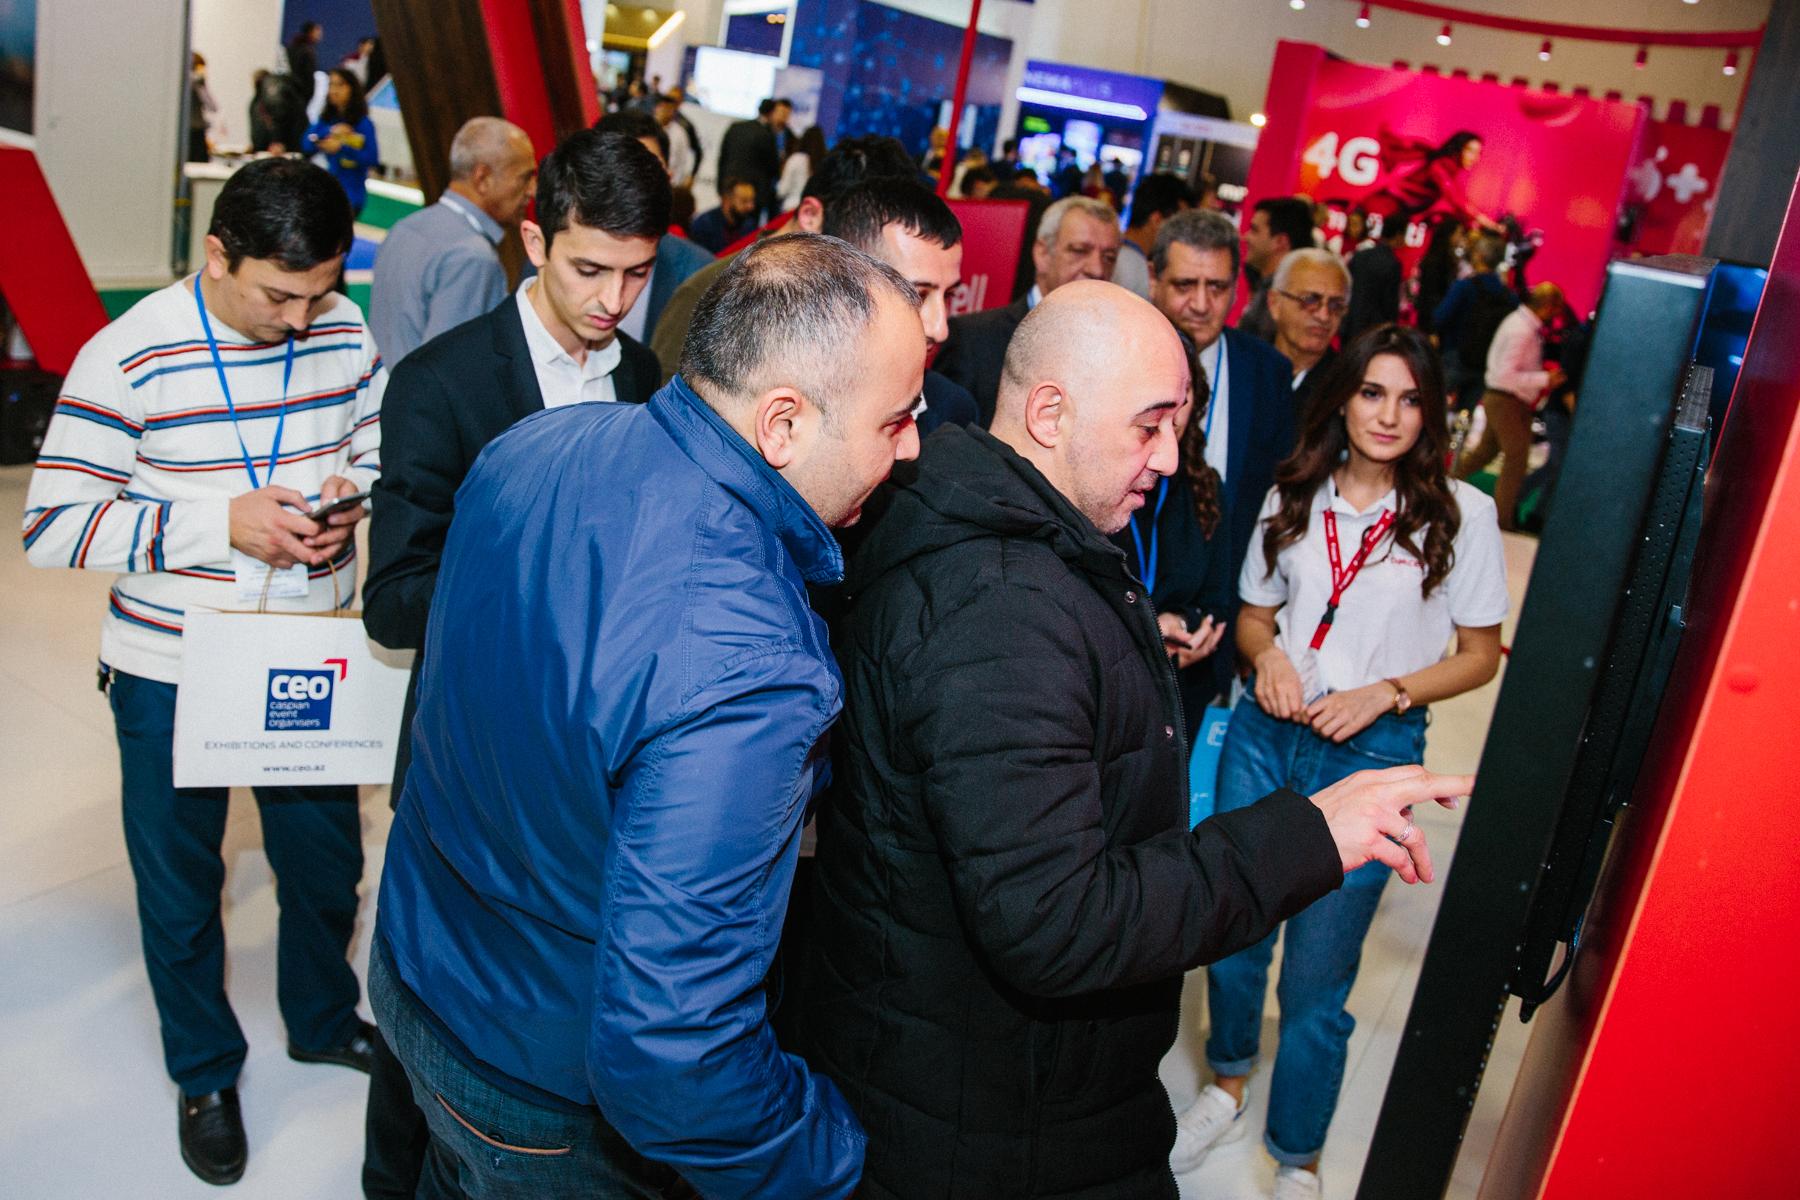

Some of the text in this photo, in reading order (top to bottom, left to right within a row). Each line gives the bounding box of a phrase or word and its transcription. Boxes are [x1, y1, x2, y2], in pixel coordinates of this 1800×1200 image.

[1303, 131, 1380, 186] 4G
[271, 674, 330, 701] ceo
[269, 701, 310, 710] caspian
[269, 709, 298, 718] event
[268, 718, 320, 729] organisers
[204, 739, 383, 750] EXHIBITIONS AND CONFERENCES
[263, 764, 326, 773] www.ceo.az
